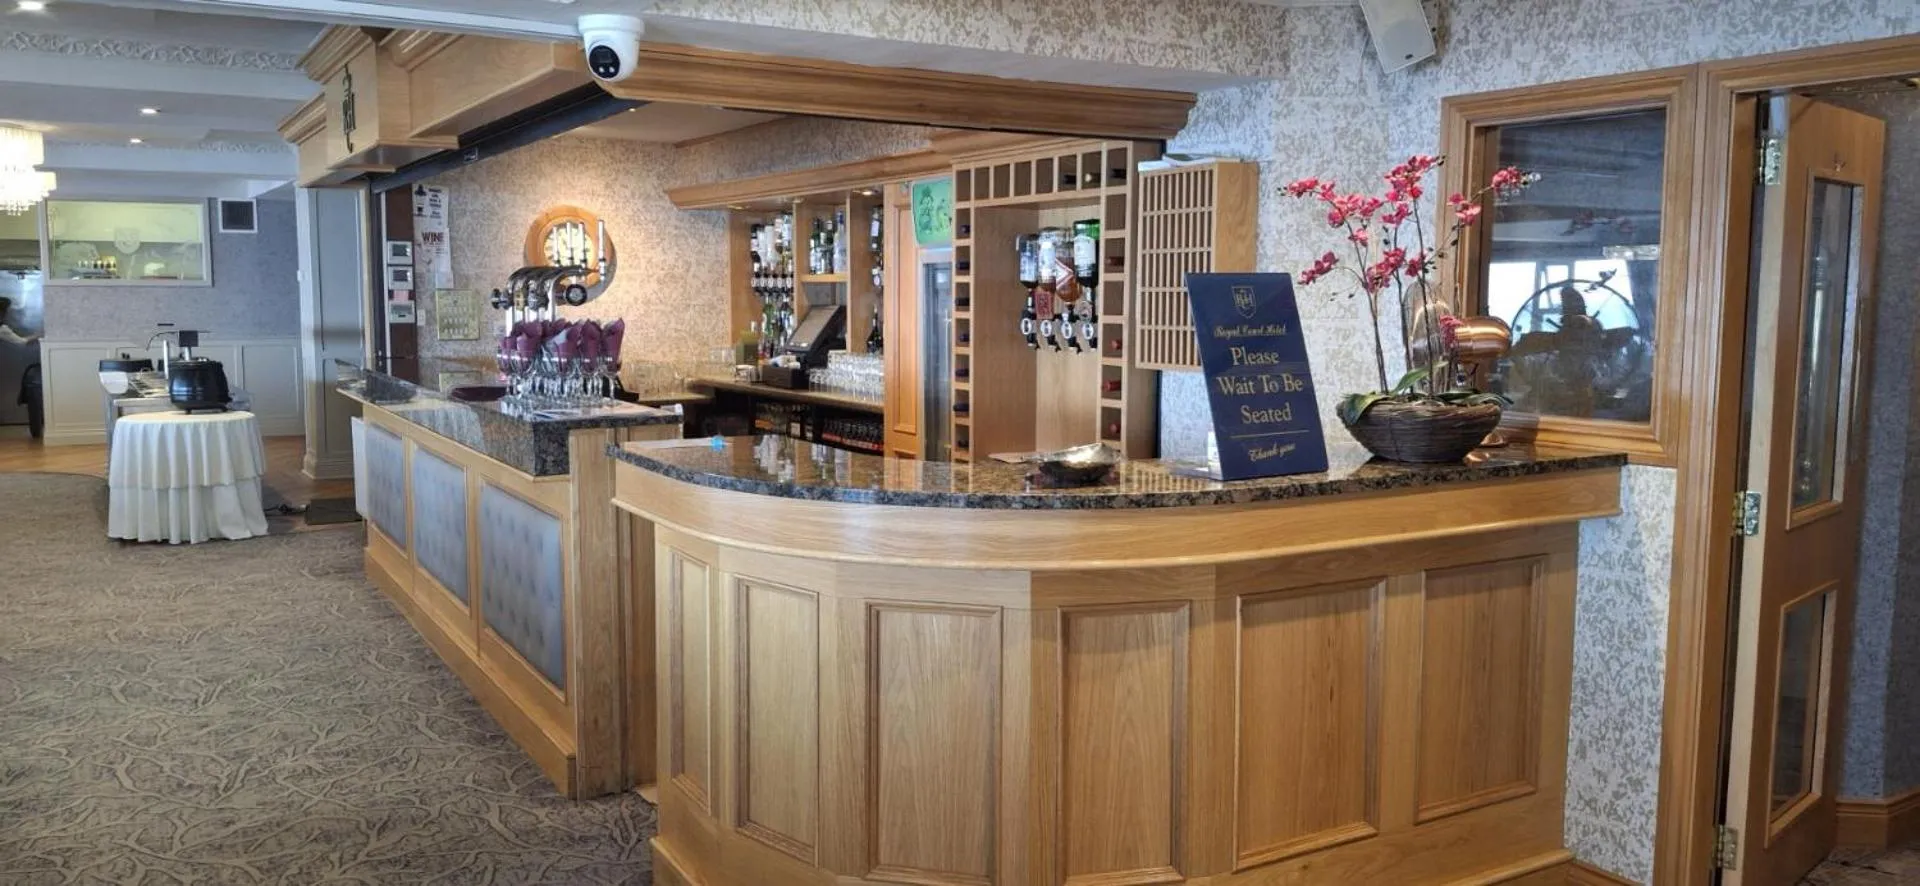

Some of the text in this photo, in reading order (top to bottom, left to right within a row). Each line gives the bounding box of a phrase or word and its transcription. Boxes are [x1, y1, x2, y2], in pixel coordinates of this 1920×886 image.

[1213, 325, 1240, 340] Royal
[1230, 346, 1280, 366] Please
[1216, 373, 1304, 395] Wait To Be
[1240, 402, 1293, 424] Seated
[1248, 441, 1296, 462] Thank you
